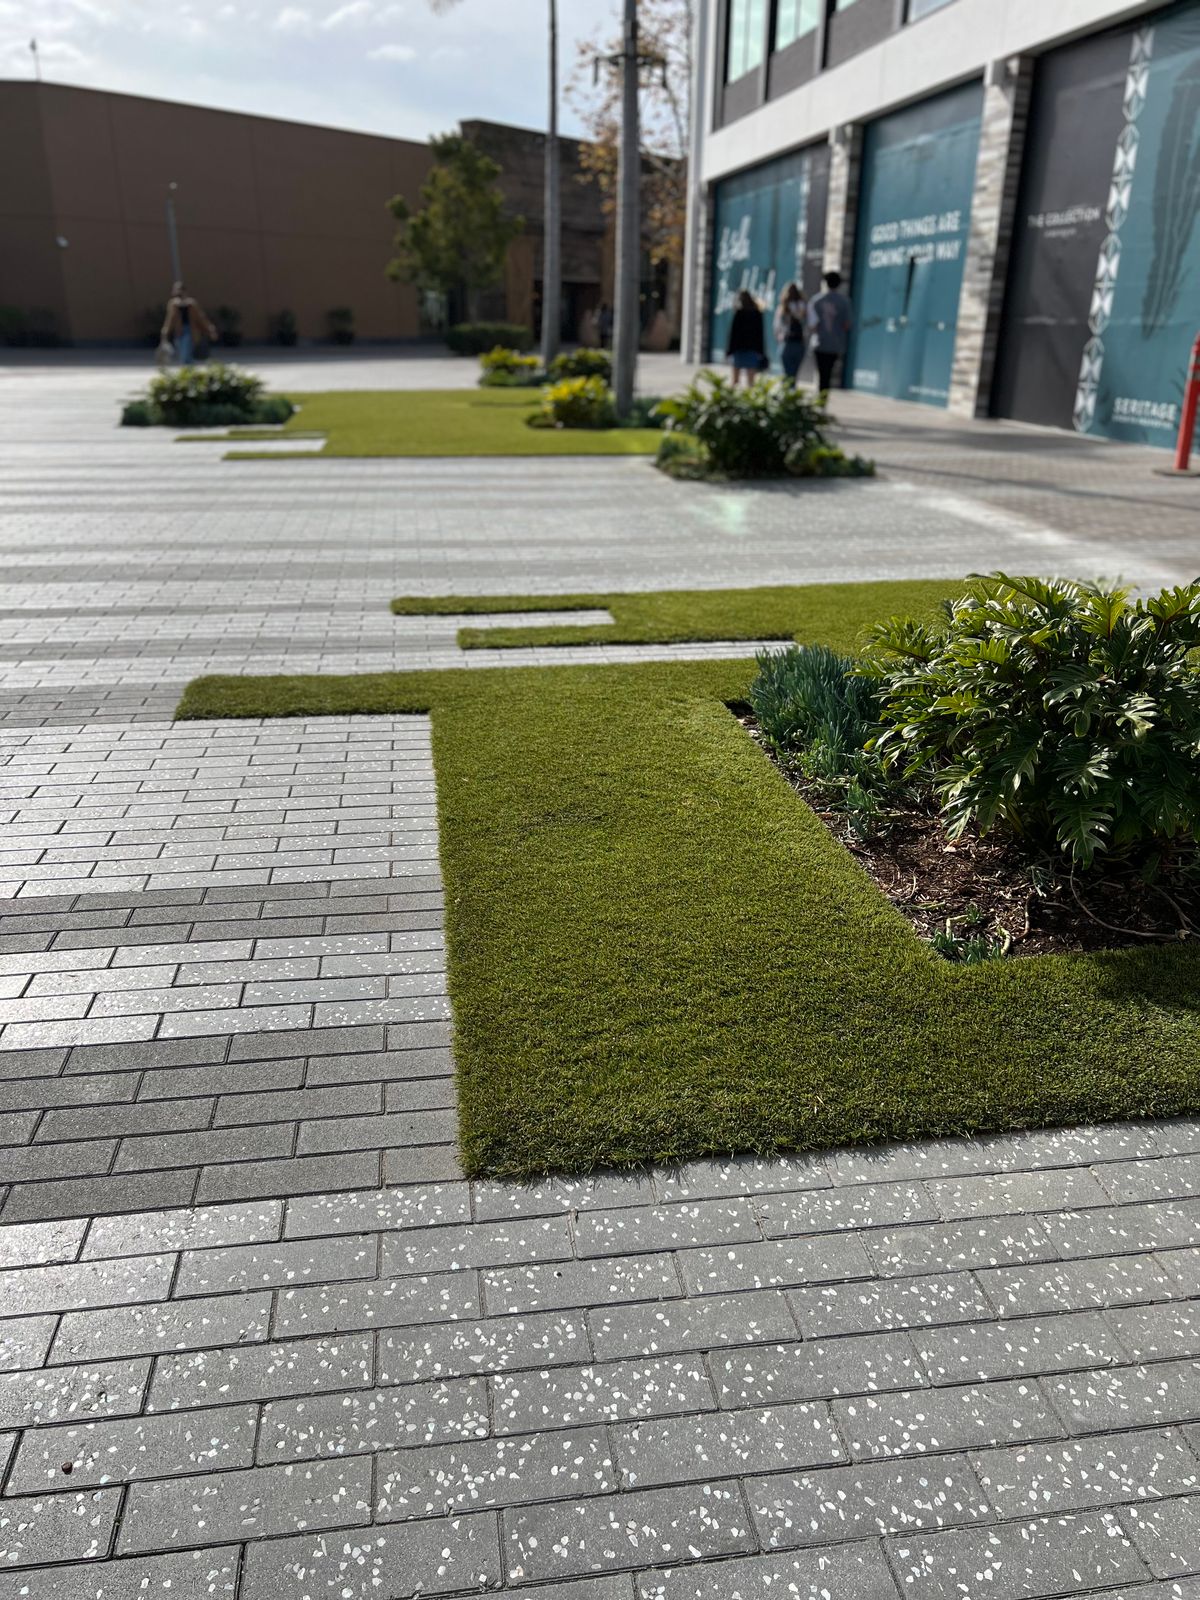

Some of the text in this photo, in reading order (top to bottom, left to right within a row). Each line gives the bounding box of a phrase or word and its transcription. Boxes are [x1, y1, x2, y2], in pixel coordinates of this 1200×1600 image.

[871, 210, 961, 244] GOOD THINGS ARE
[1045, 207, 1100, 228] COLLECTION
[869, 245, 904, 269] COMING
[935, 239, 961, 261] WAY
[1113, 397, 1176, 421] SERITAGE
